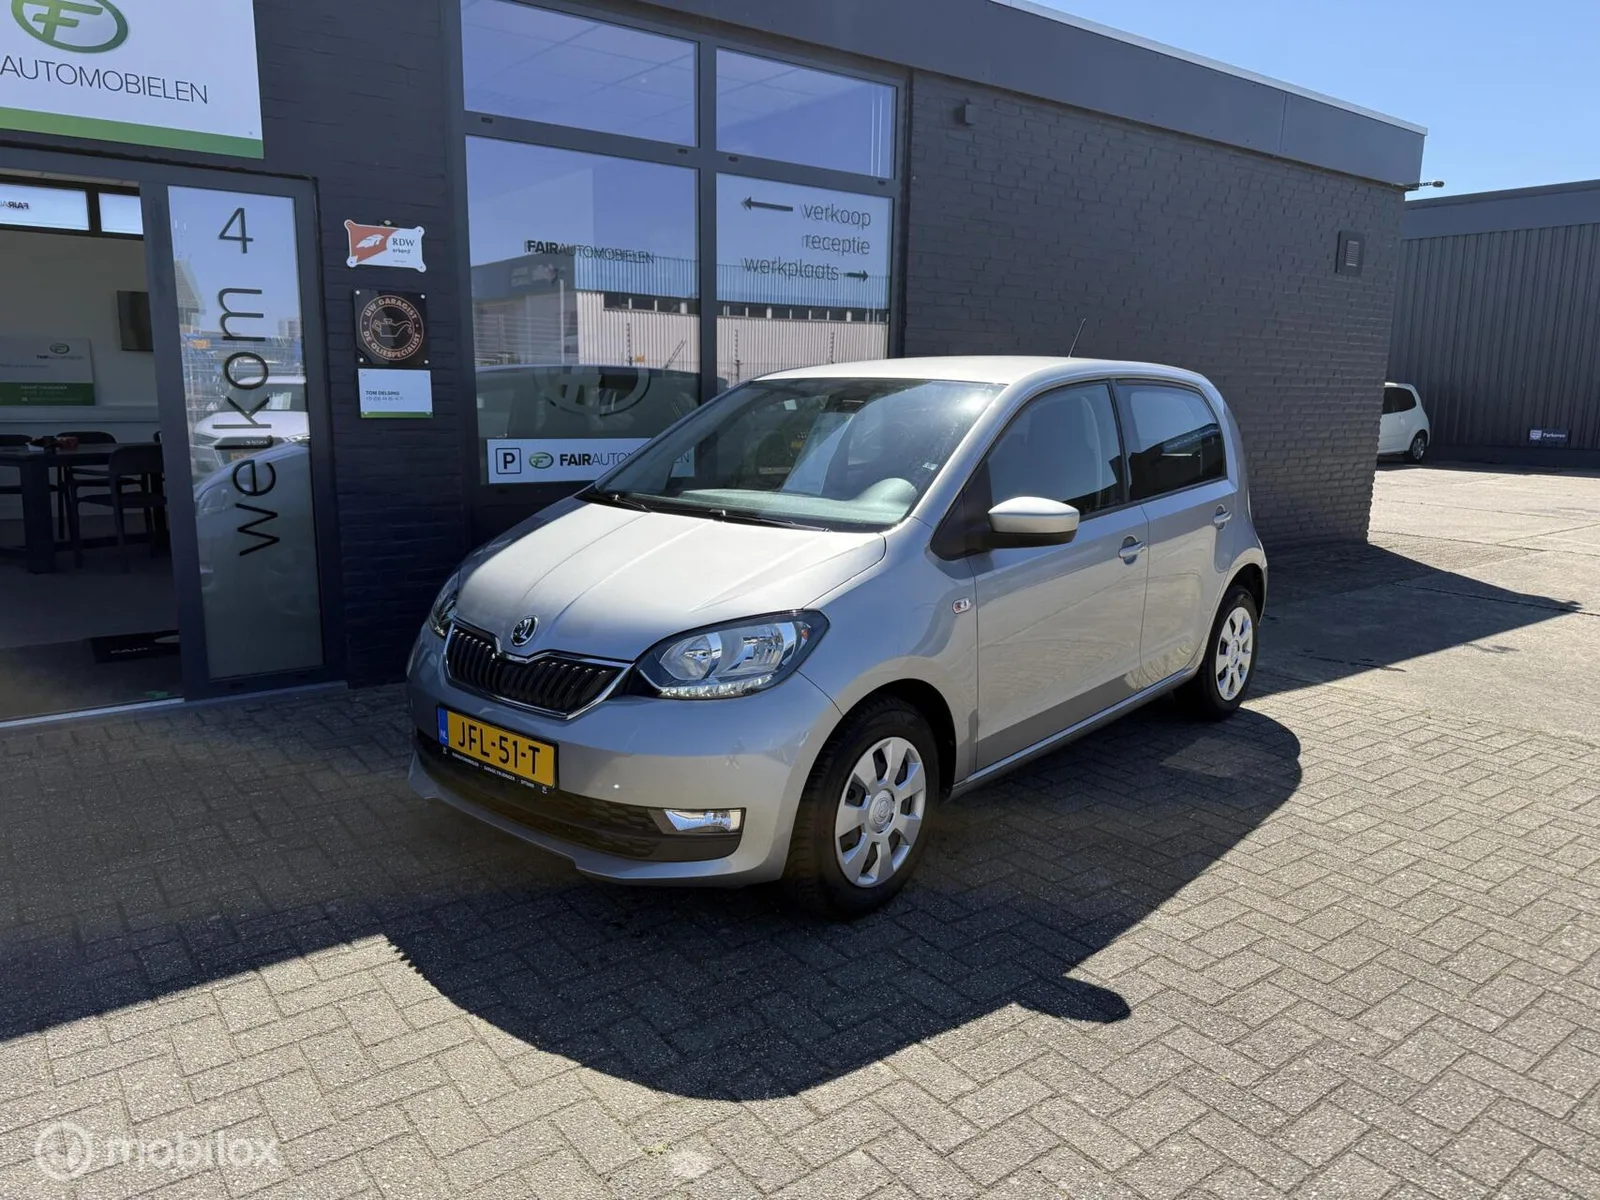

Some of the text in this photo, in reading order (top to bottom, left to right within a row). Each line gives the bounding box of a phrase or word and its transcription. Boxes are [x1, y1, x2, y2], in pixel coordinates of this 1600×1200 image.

[0, 55, 208, 104] AUTOMOBIELEN
[218, 207, 254, 254] 4
[802, 203, 871, 231] verkoop
[392, 238, 415, 247] RDW
[803, 234, 871, 256] receptie
[743, 256, 839, 281] werkplaats
[365, 298, 417, 319] UW GARAGIST
[363, 330, 421, 358] DE OLIESPECIALIST
[211, 287, 281, 557] welkom
[503, 452, 515, 470] P
[458, 721, 541, 775] JFL-51-T
